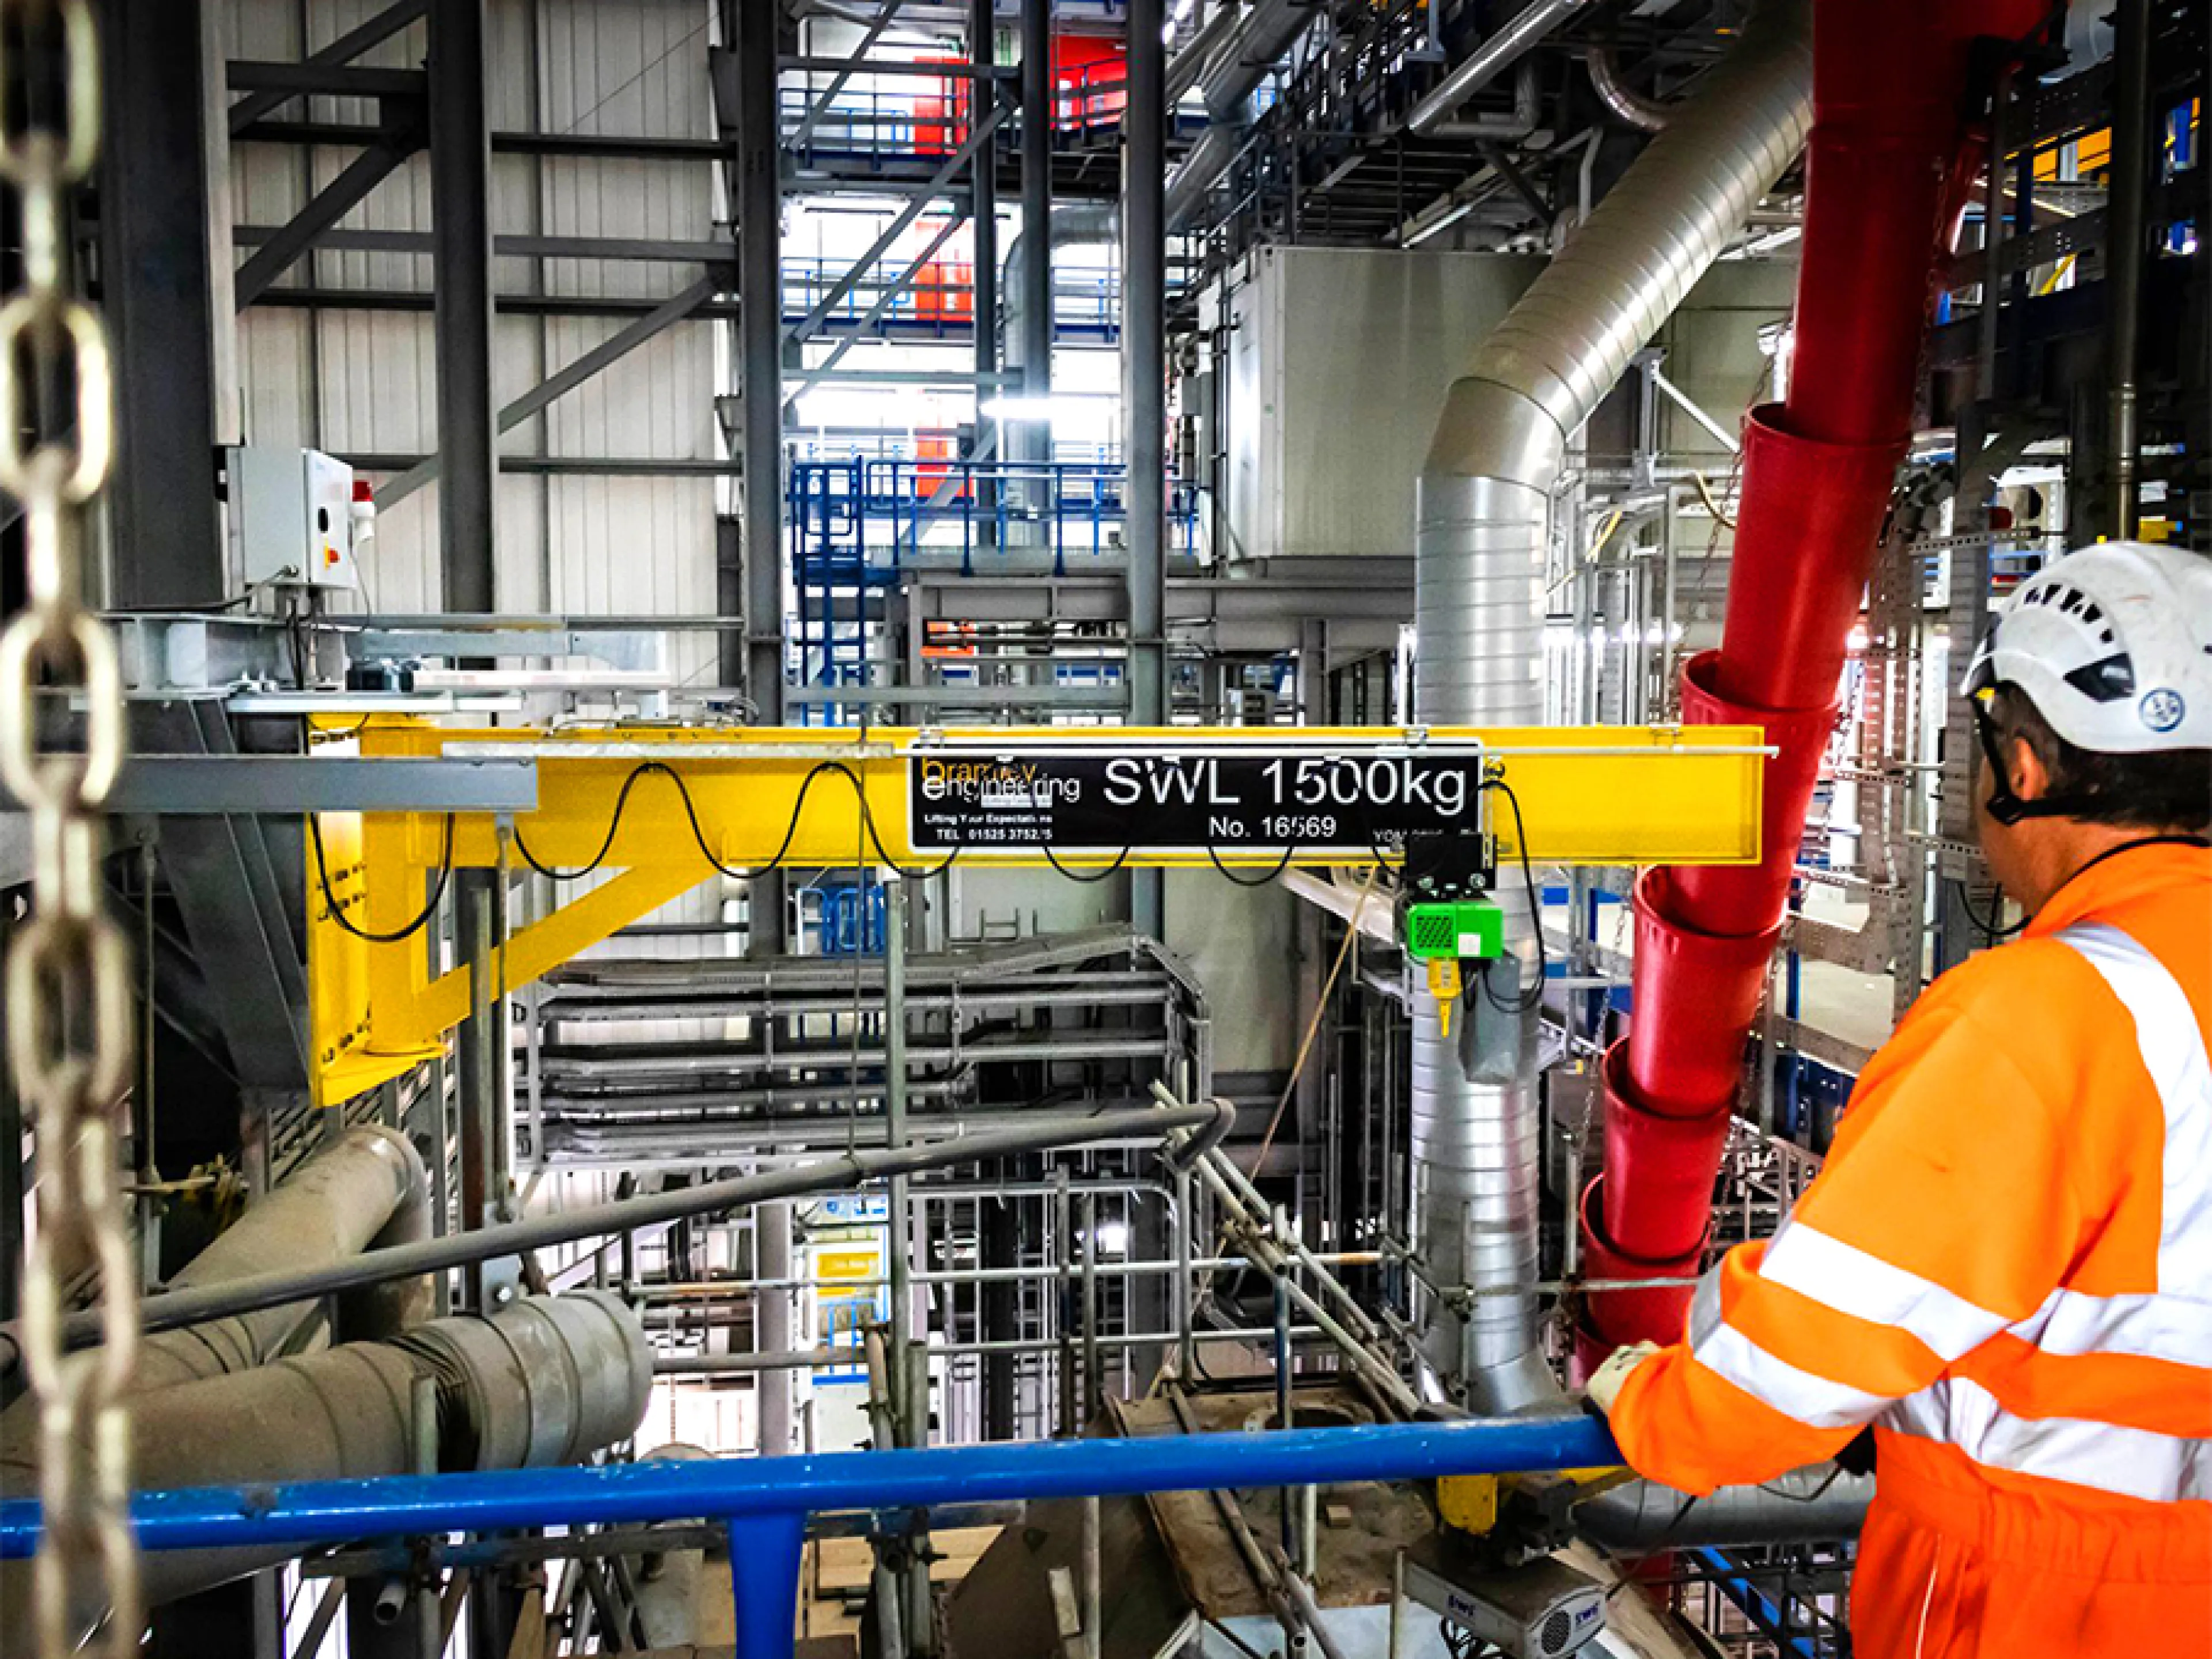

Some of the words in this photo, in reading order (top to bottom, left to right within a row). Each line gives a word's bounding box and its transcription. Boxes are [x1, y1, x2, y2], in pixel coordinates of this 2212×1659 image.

[922, 774, 1081, 803] engineering
[1103, 758, 1241, 805] SWL
[1262, 758, 1467, 816] 1500kg
[1209, 815, 1251, 837] No.
[1260, 815, 1336, 837] 16569
